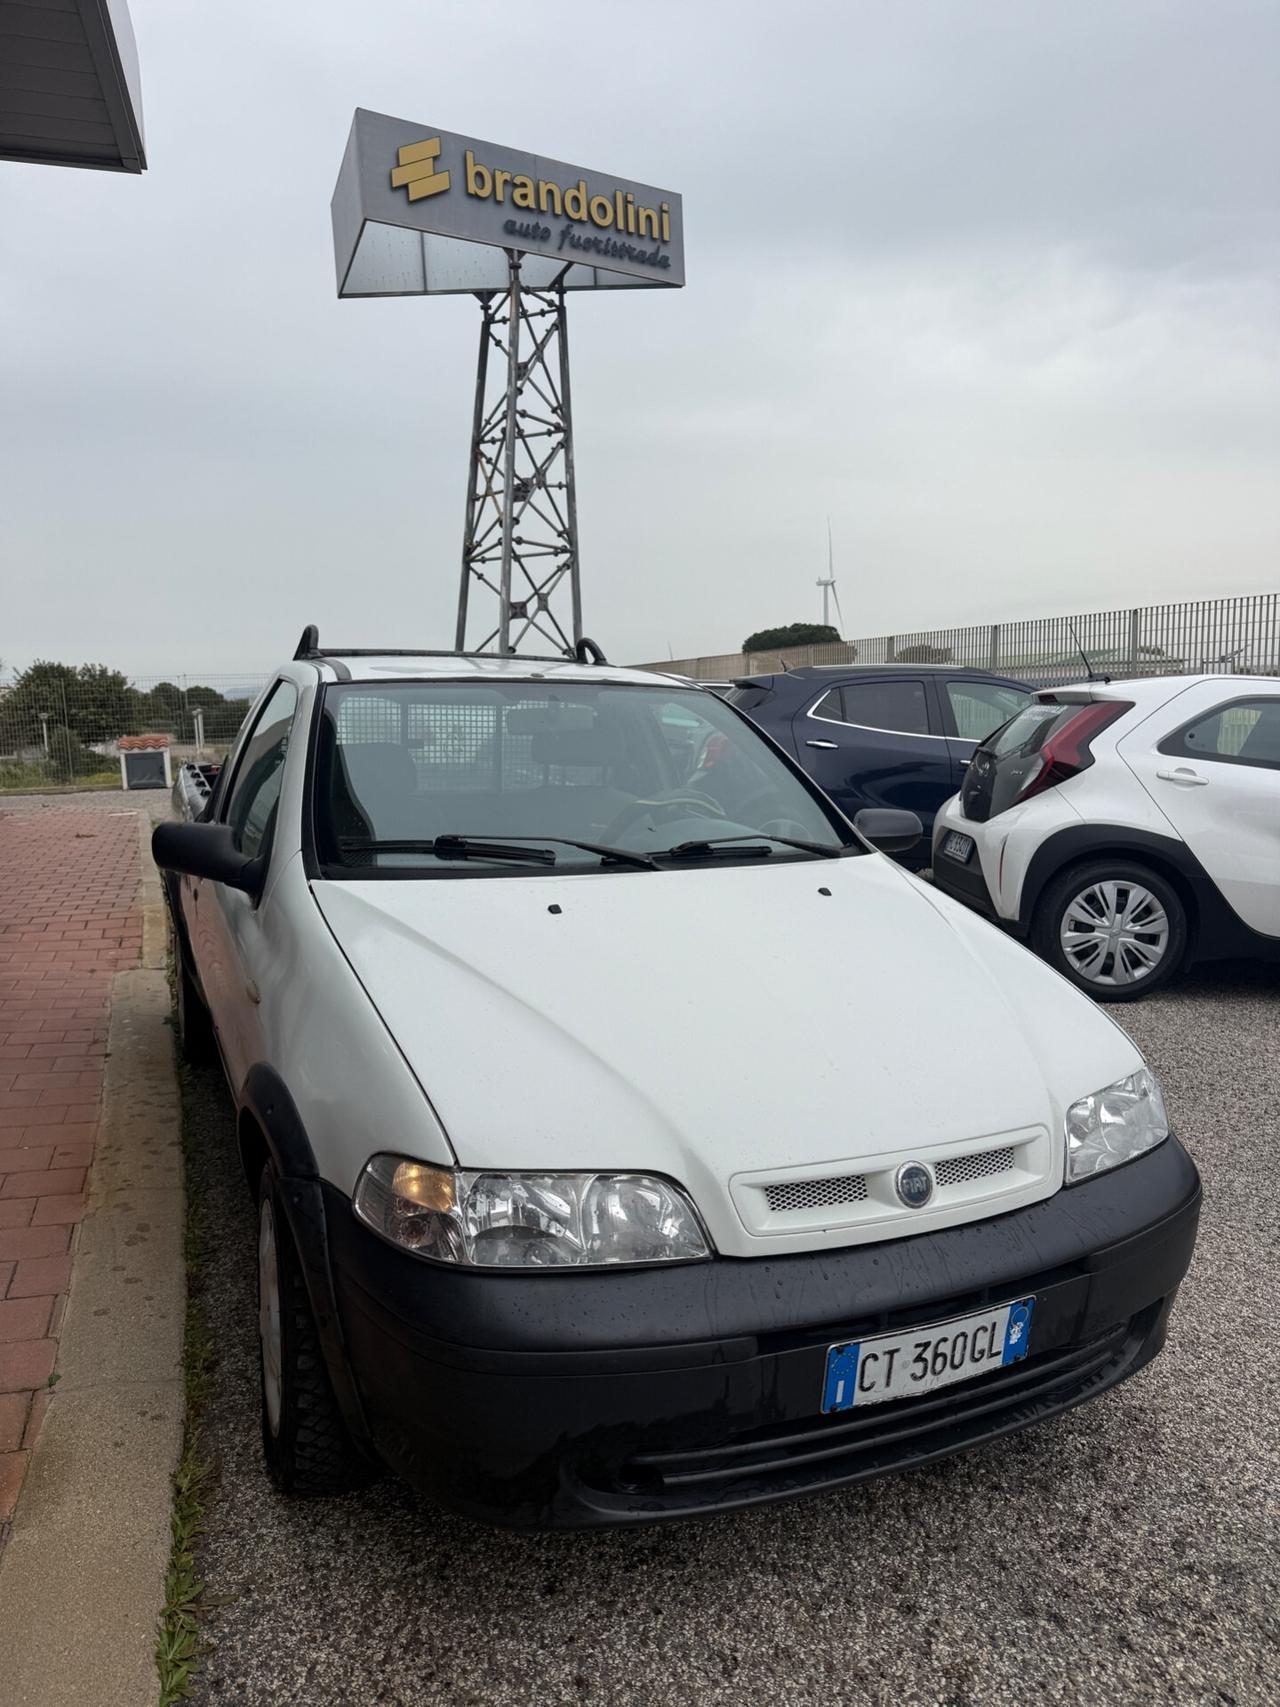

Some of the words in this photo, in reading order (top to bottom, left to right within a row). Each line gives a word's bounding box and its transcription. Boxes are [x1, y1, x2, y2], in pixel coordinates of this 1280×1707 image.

[465, 150, 671, 242] brandolini
[504, 217, 552, 241] auto
[558, 223, 671, 269] fuoristrada
[859, 1347, 900, 1392] CT
[910, 1321, 1002, 1382] 360GL
